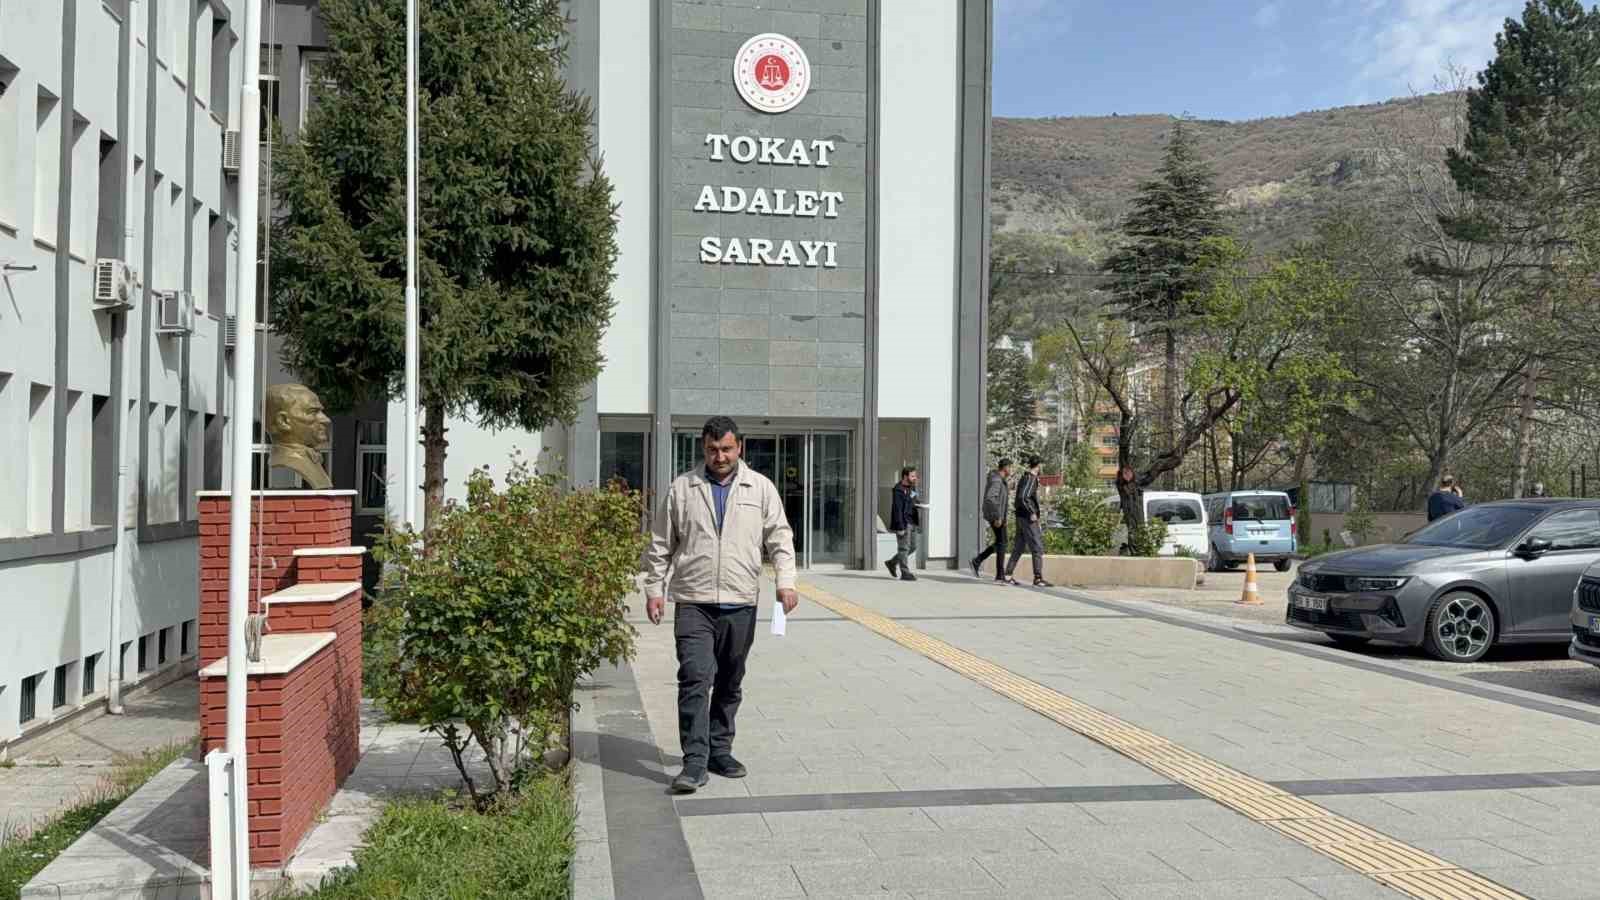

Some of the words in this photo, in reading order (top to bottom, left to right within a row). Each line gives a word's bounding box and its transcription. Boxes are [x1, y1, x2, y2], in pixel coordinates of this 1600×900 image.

[705, 133, 835, 166] TOKAT
[694, 185, 844, 217] ADALET
[700, 236, 838, 267] SARAYI
